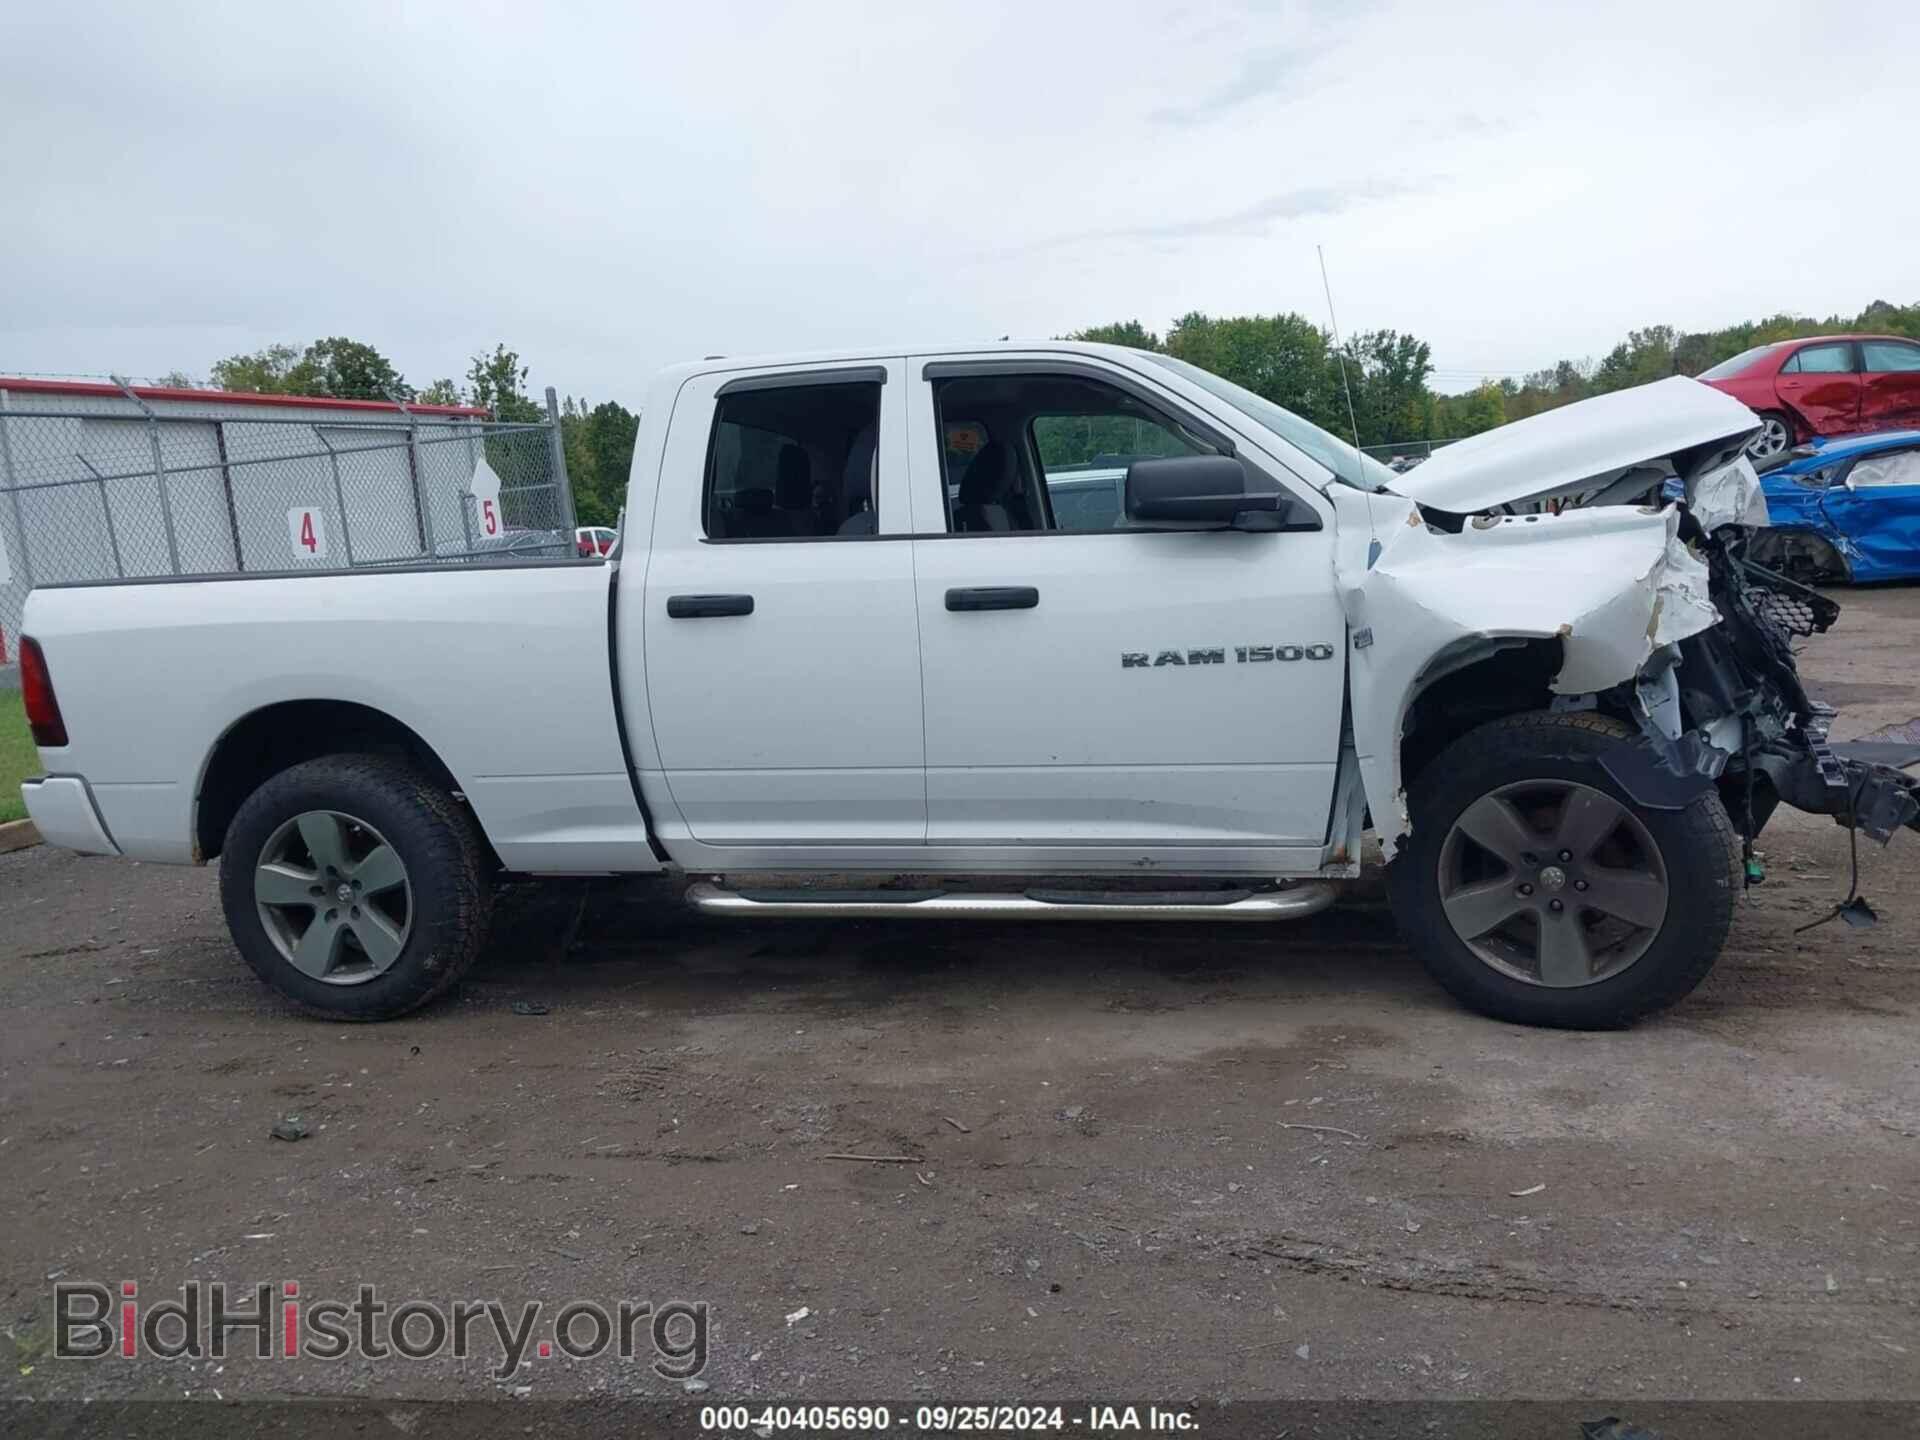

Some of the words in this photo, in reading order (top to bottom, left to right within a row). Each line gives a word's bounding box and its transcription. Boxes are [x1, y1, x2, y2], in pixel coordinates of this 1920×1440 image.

[301, 512, 316, 553] 4
[483, 501, 496, 535] 5
[1121, 648, 1225, 668] RAM
[1234, 643, 1334, 663] 1500
